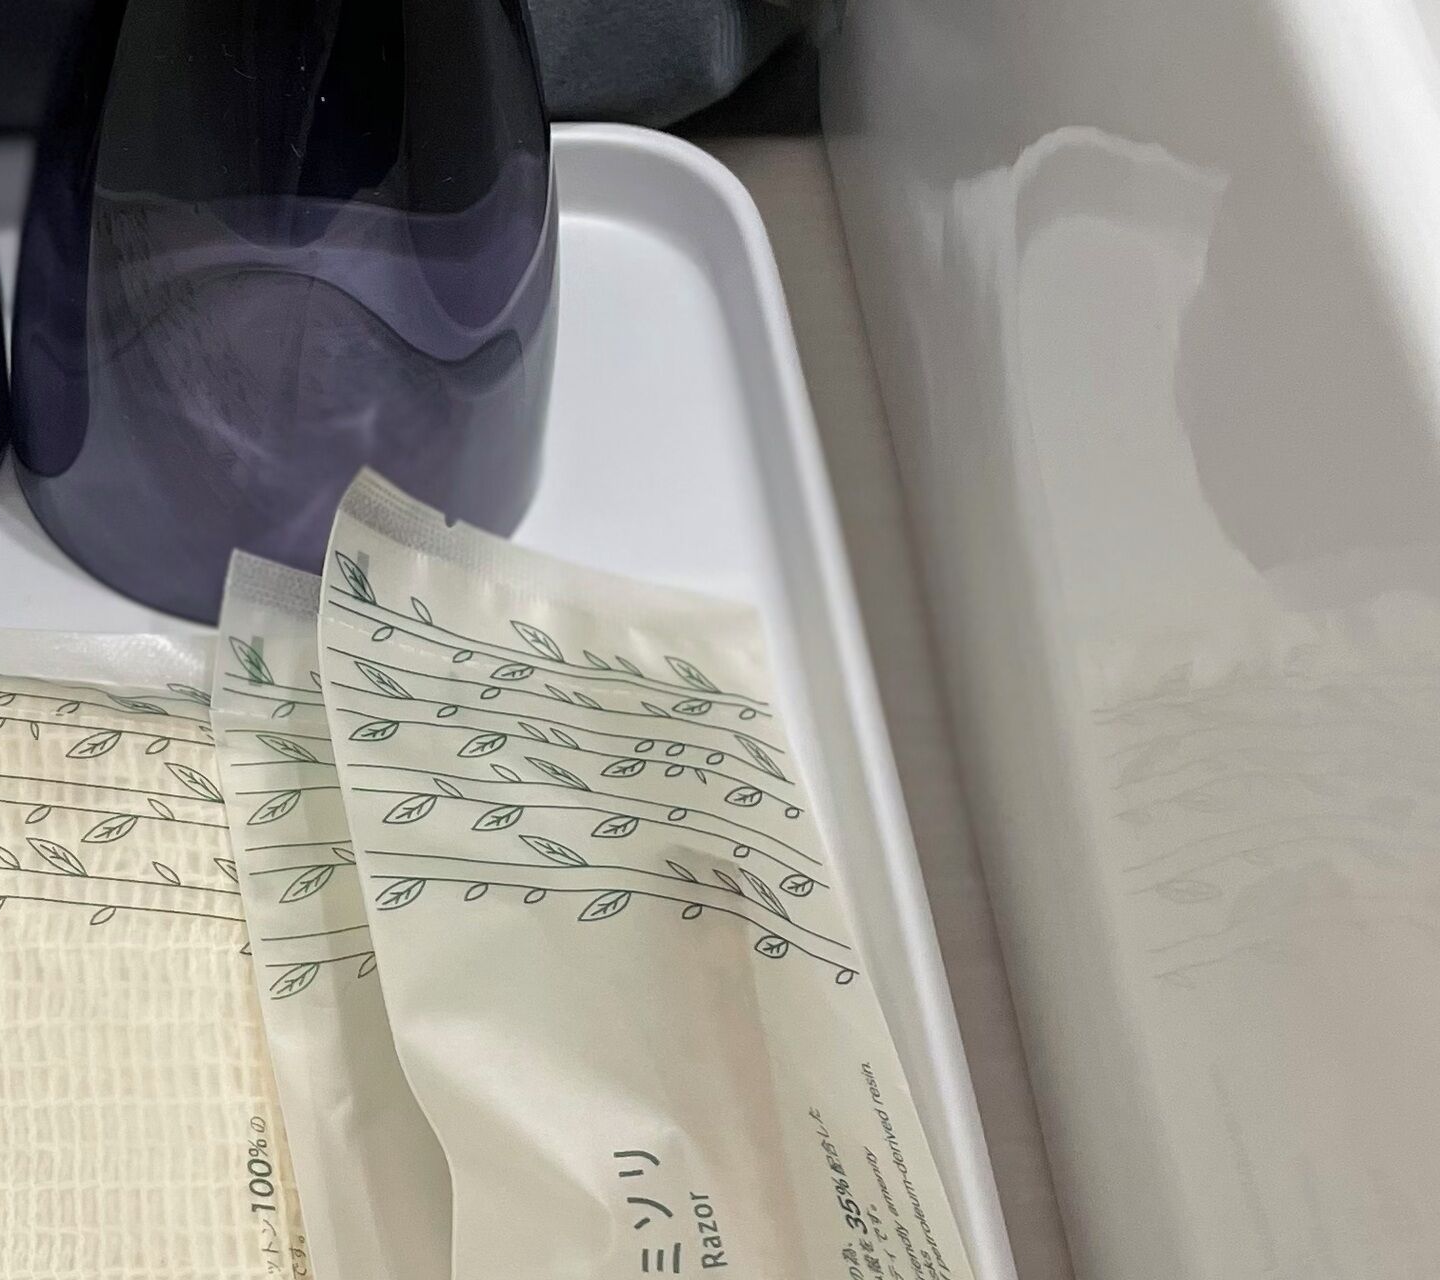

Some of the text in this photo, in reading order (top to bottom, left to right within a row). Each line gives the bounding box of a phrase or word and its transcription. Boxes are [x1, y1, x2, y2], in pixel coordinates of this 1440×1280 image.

[864, 1145, 900, 1217] amenity
[874, 1108, 951, 1272] petroleum-derived
[689, 1191, 729, 1269] Razor
